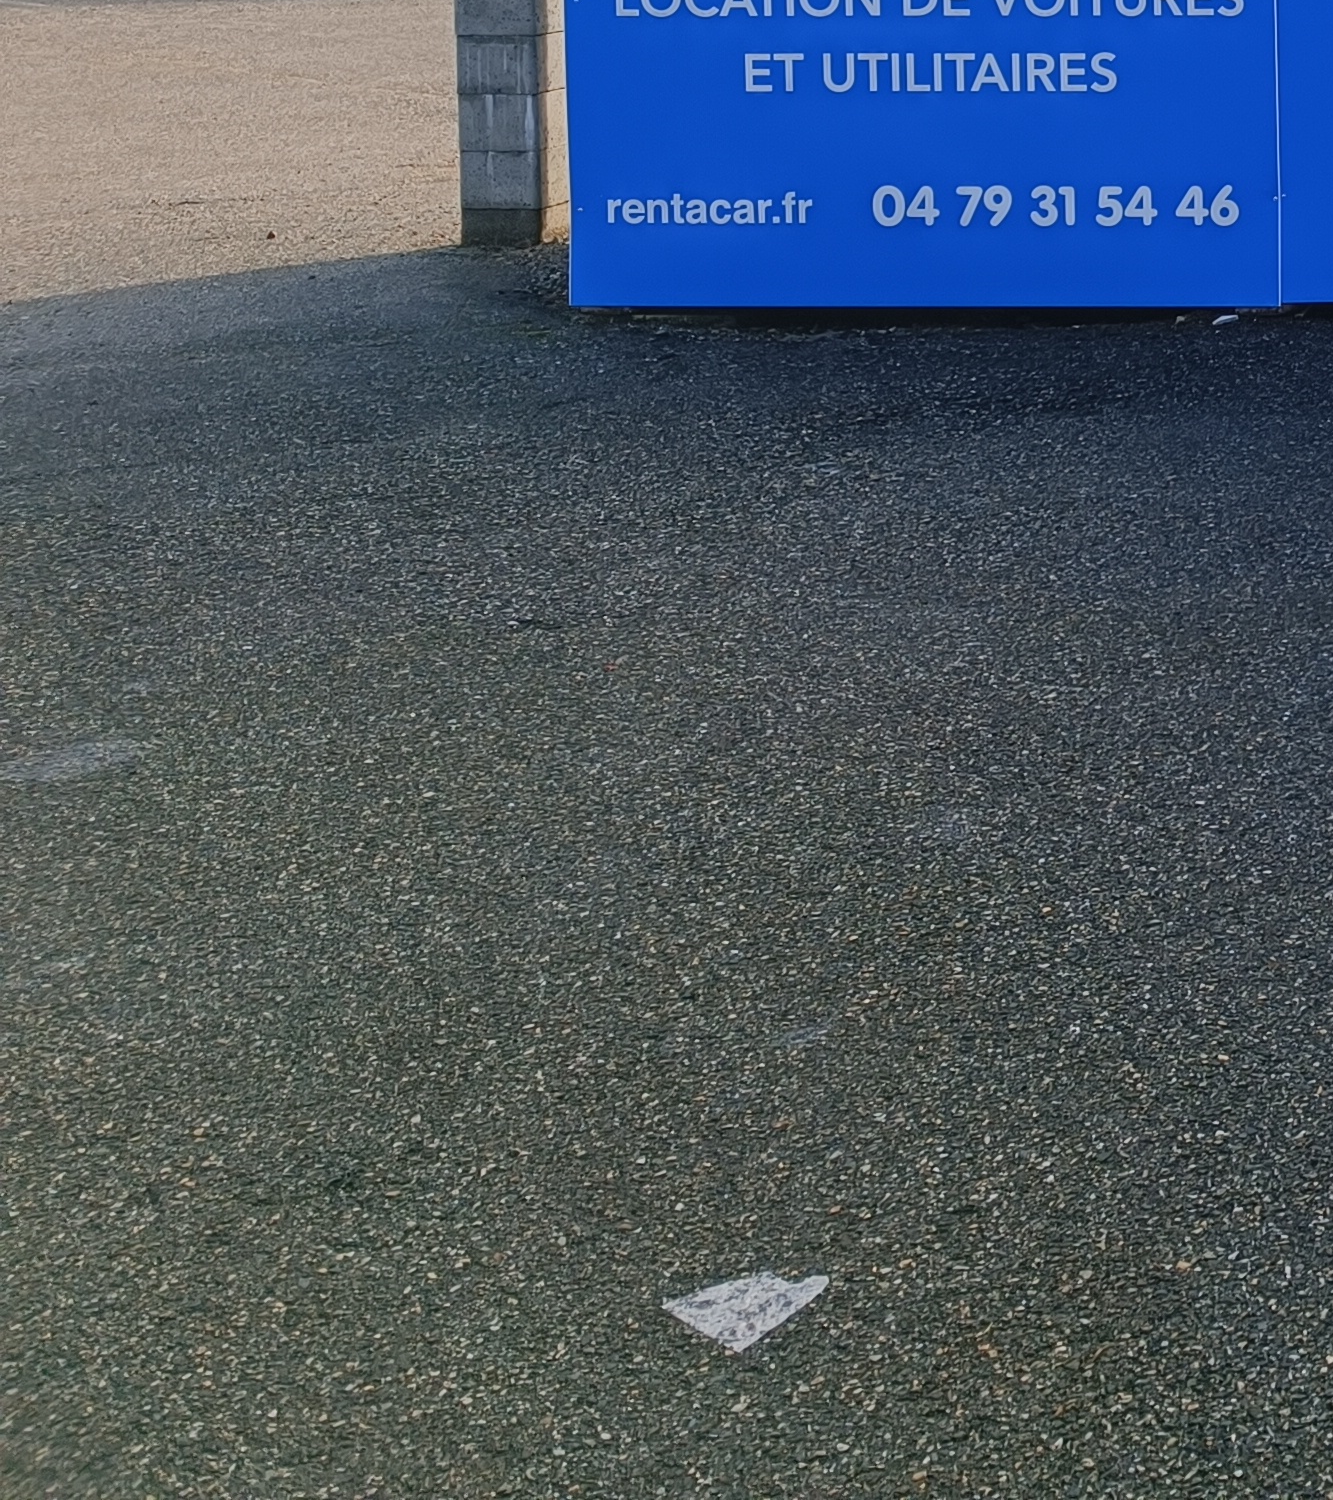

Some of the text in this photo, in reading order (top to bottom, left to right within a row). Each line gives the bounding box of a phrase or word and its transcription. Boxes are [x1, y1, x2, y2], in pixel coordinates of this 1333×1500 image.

[744, 51, 1118, 93] ET UTILITAIRES
[607, 191, 813, 225] rentacar.fr
[872, 184, 1240, 227] 04 79 31 54 46
